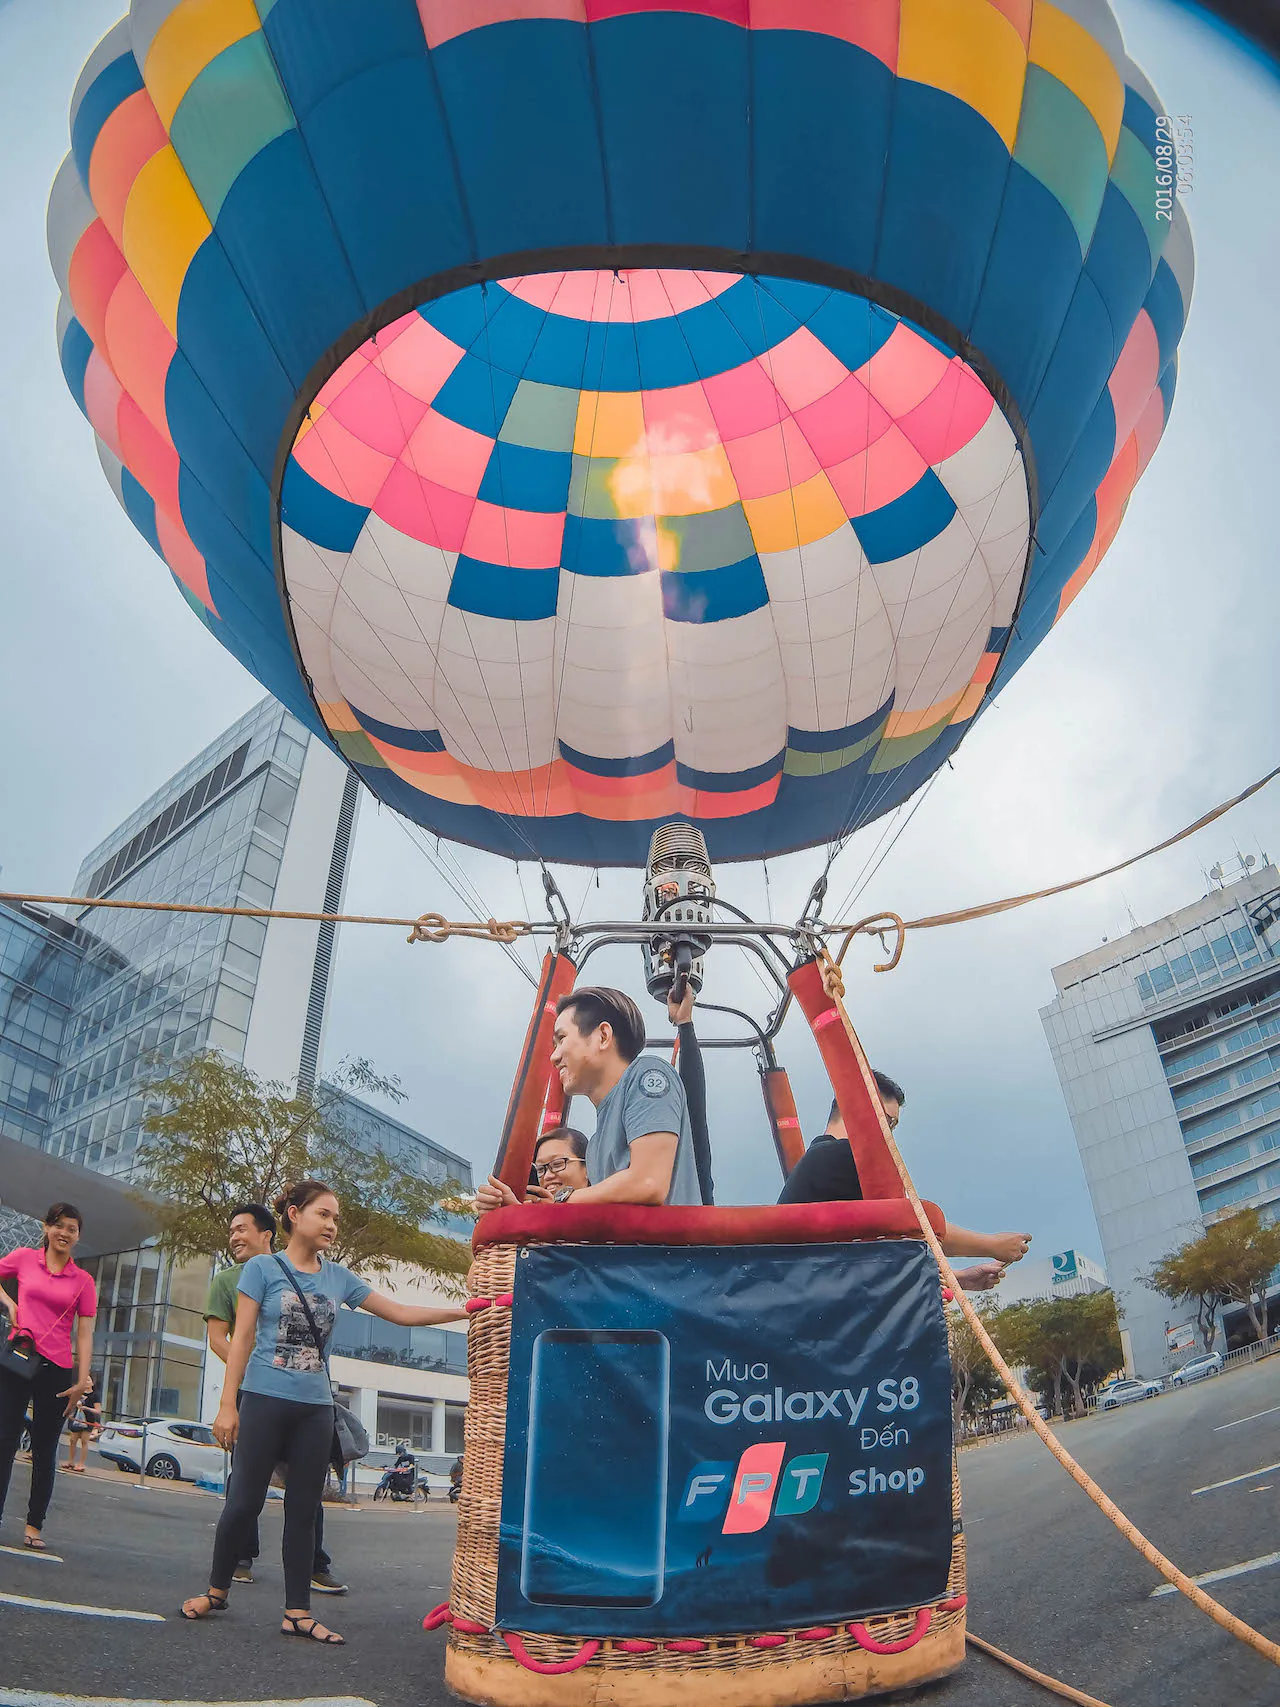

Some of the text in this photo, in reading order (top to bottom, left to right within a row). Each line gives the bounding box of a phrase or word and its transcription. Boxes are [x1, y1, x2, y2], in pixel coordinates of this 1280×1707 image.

[647, 1078, 662, 1089] 32
[706, 1358, 769, 1382] Mua
[704, 1376, 920, 1425] Galaxy S8
[376, 1432, 412, 1449] Plaza
[860, 1421, 909, 1450] Đến
[685, 1466, 925, 1507] FPT Shop
